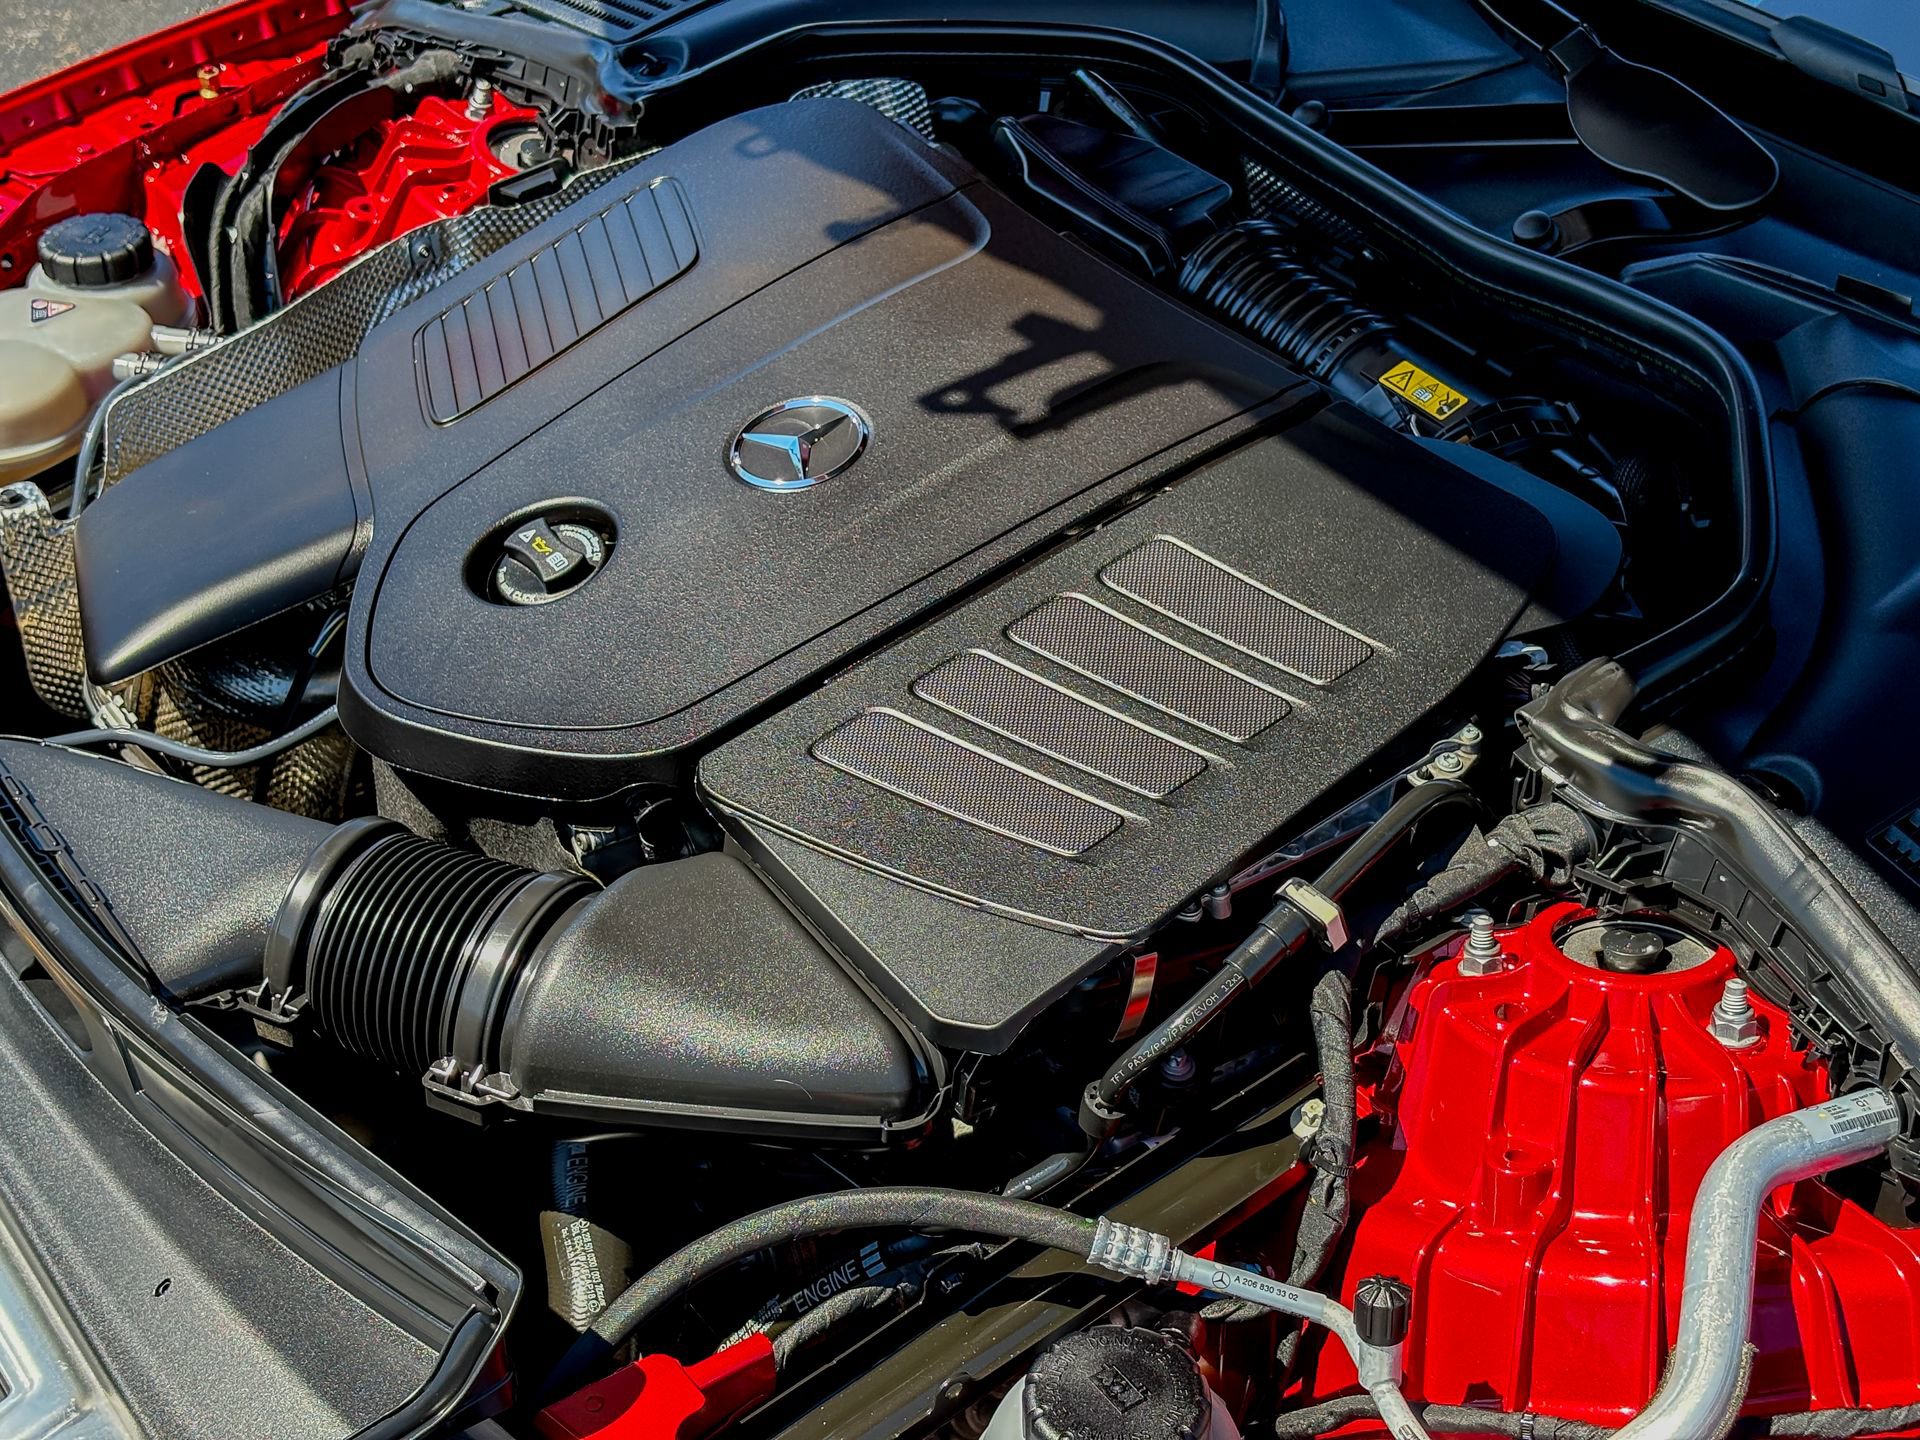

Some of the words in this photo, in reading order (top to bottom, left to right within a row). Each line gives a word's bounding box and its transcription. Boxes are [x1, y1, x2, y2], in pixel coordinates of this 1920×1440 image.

[1110, 1070, 1126, 1085] TFT
[565, 1156, 589, 1207] ENGINE
[793, 1259, 860, 1313] ENGINE
[1234, 1276, 1240, 1284] A
[1242, 1278, 1257, 1288] 206
[1259, 1283, 1274, 1294] 830
[1276, 1289, 1286, 1298] 33
[1288, 1293, 1299, 1302] 02
